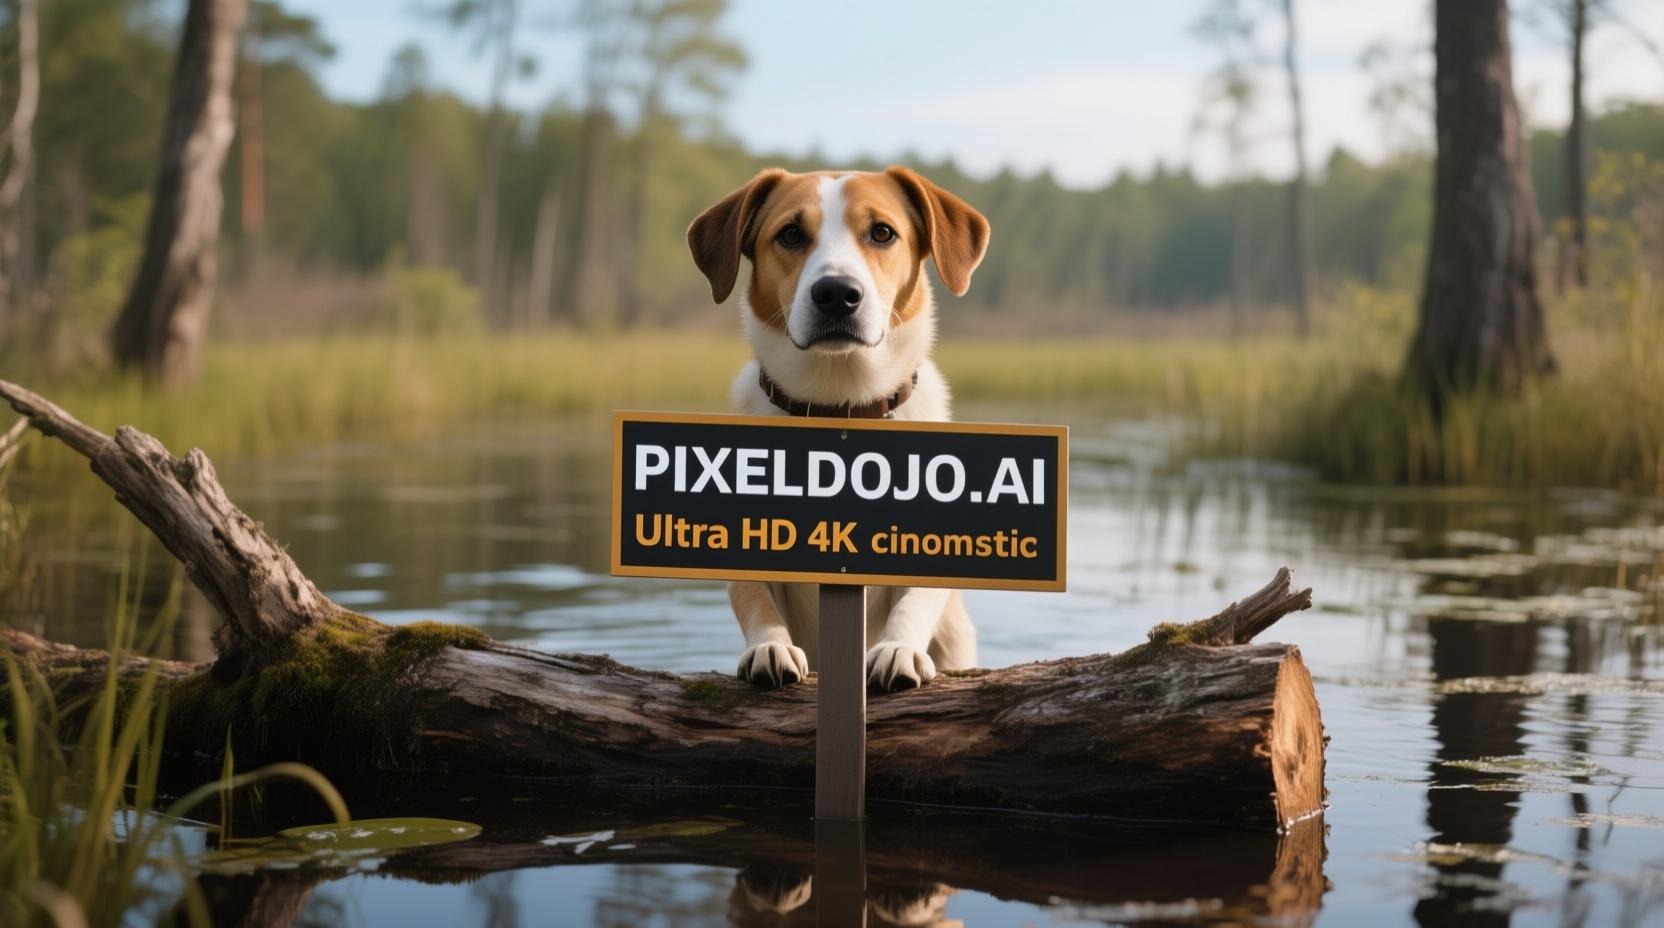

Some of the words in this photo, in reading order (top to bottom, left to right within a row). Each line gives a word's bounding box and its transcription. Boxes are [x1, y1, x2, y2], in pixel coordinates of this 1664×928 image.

[634, 444, 1045, 505] PIXELDOJO.AI
[635, 513, 729, 549] Ultra
[742, 517, 797, 551] HD
[807, 520, 859, 553] 4K
[871, 525, 1038, 559] cinomstic
